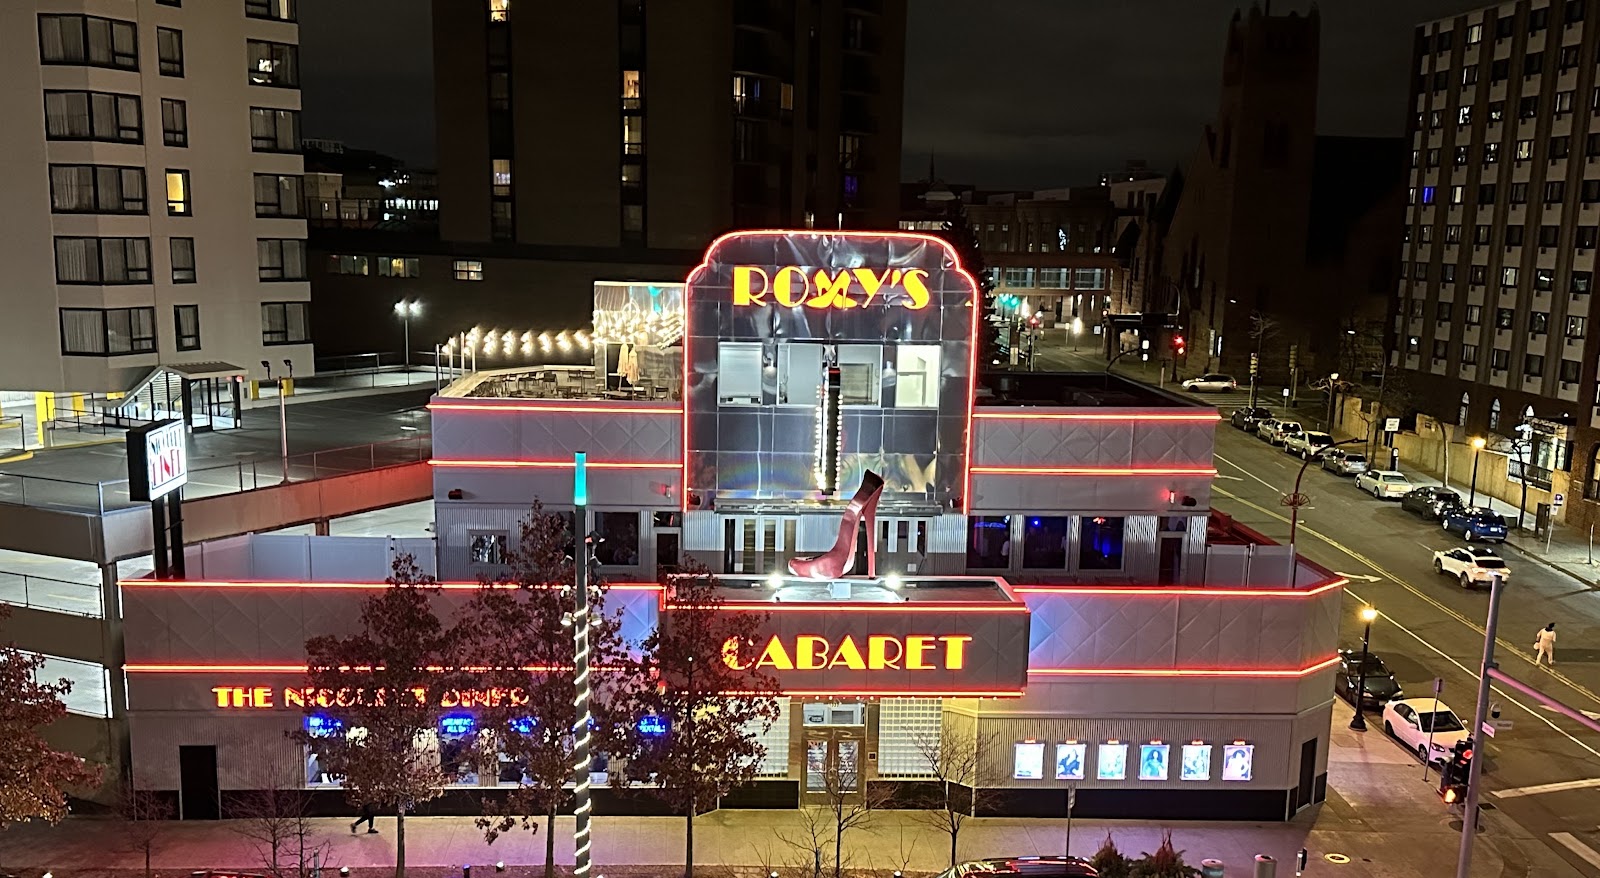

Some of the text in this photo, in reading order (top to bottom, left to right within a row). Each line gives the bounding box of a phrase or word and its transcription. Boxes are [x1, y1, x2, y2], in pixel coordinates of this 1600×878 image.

[733, 265, 930, 310] ROXY'S
[720, 634, 973, 670] CABARET
[211, 686, 274, 708] THE
[284, 686, 429, 708] NICOLLT
